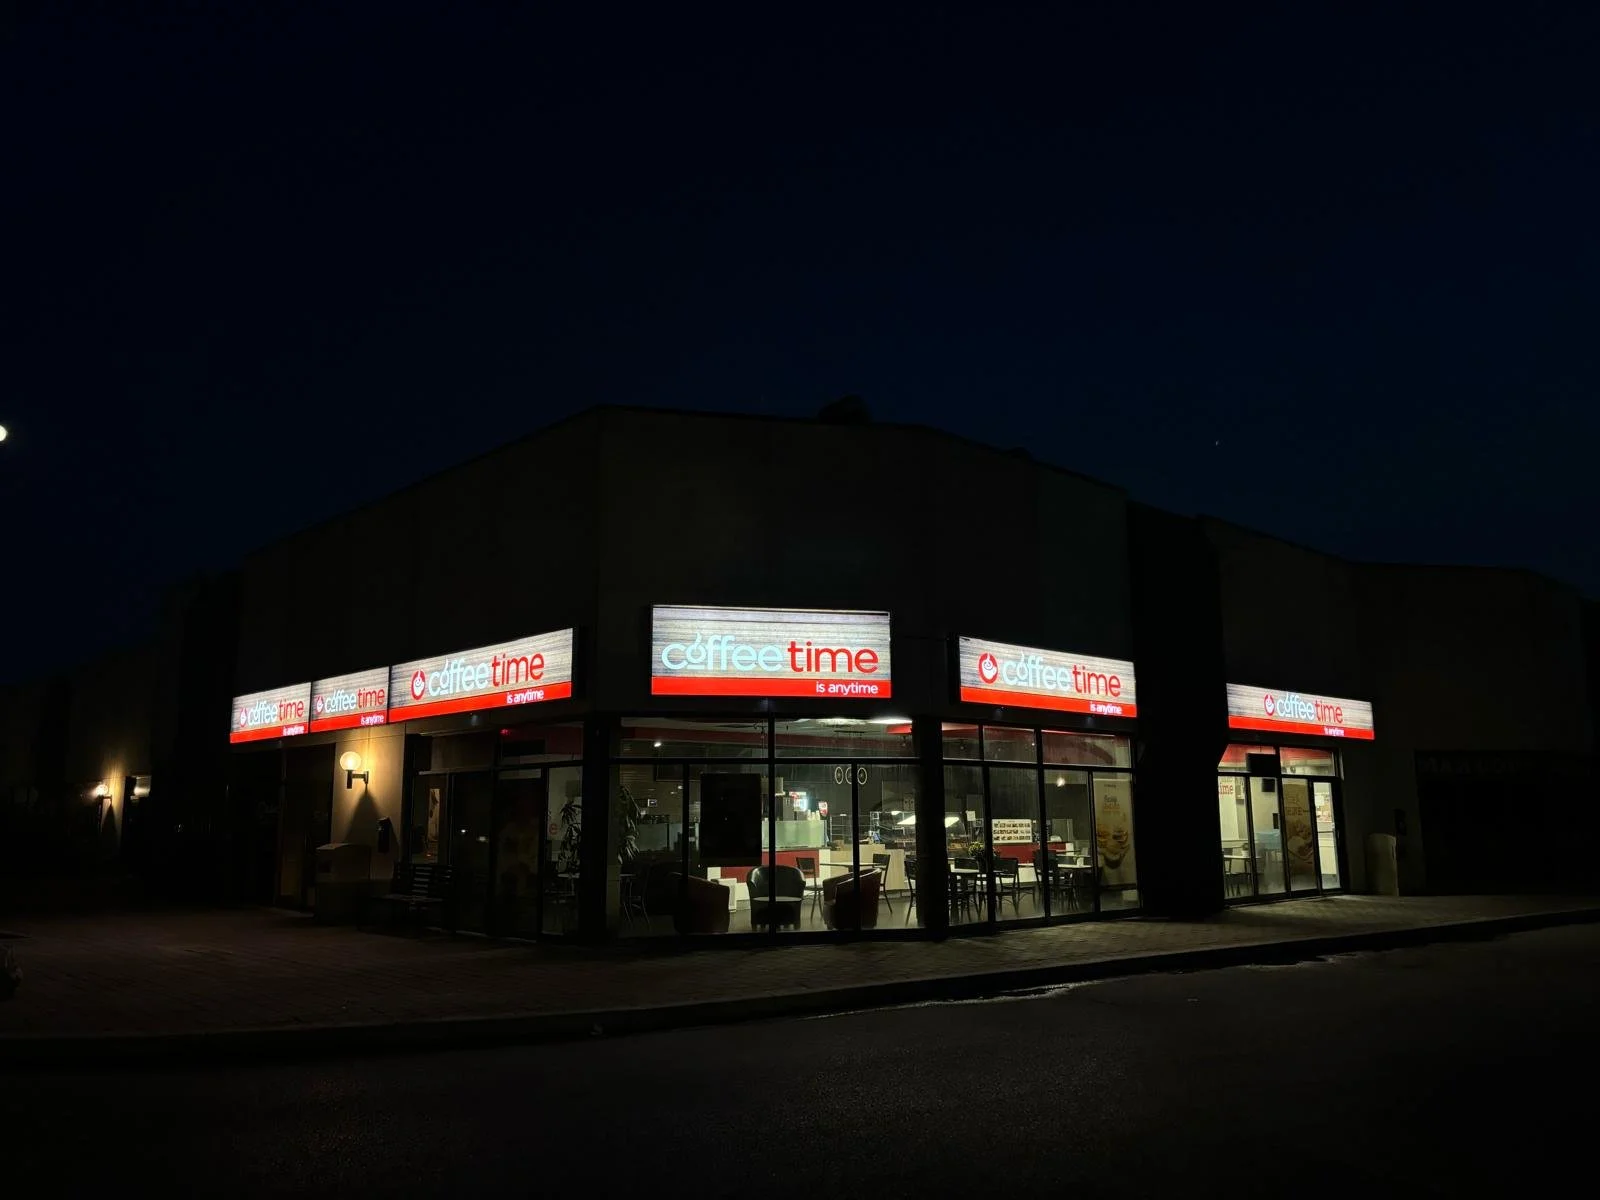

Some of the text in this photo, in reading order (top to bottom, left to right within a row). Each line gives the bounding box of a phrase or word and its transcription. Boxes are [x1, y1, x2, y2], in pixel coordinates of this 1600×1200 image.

[661, 632, 879, 674] coffee time
[428, 653, 545, 697] coffee time
[1002, 651, 1121, 697] coffee time
[325, 687, 385, 713] coffee time
[507, 689, 544, 704] is anytime
[816, 681, 879, 696] is anytime
[248, 699, 305, 725] coffee time
[1097, 703, 1122, 715] anytime
[1276, 692, 1343, 723] coffee time
